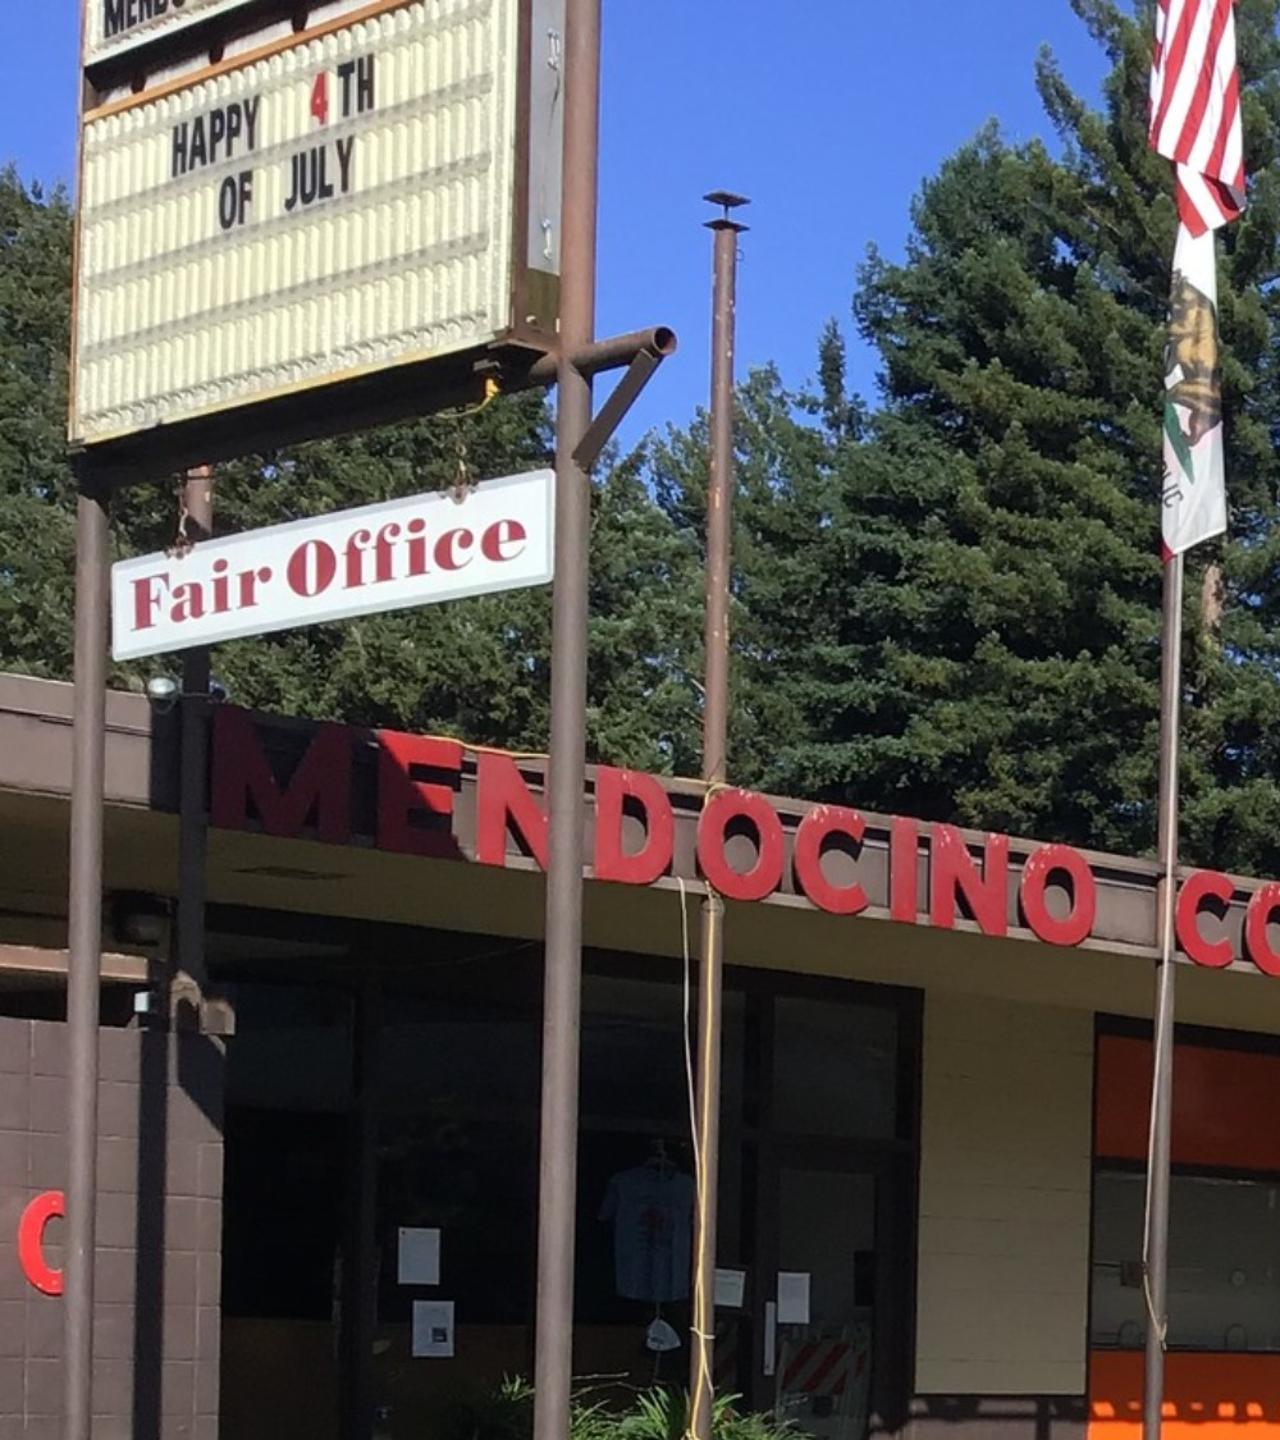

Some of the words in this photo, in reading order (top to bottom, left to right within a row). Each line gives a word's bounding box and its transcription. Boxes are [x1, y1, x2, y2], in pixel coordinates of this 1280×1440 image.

[172, 95, 259, 177] HAPPY
[219, 170, 253, 229] OF
[285, 136, 354, 211] JULY
[130, 559, 273, 631] Fair
[287, 518, 527, 597] Office
[211, 702, 1096, 945] MENDOCINO
